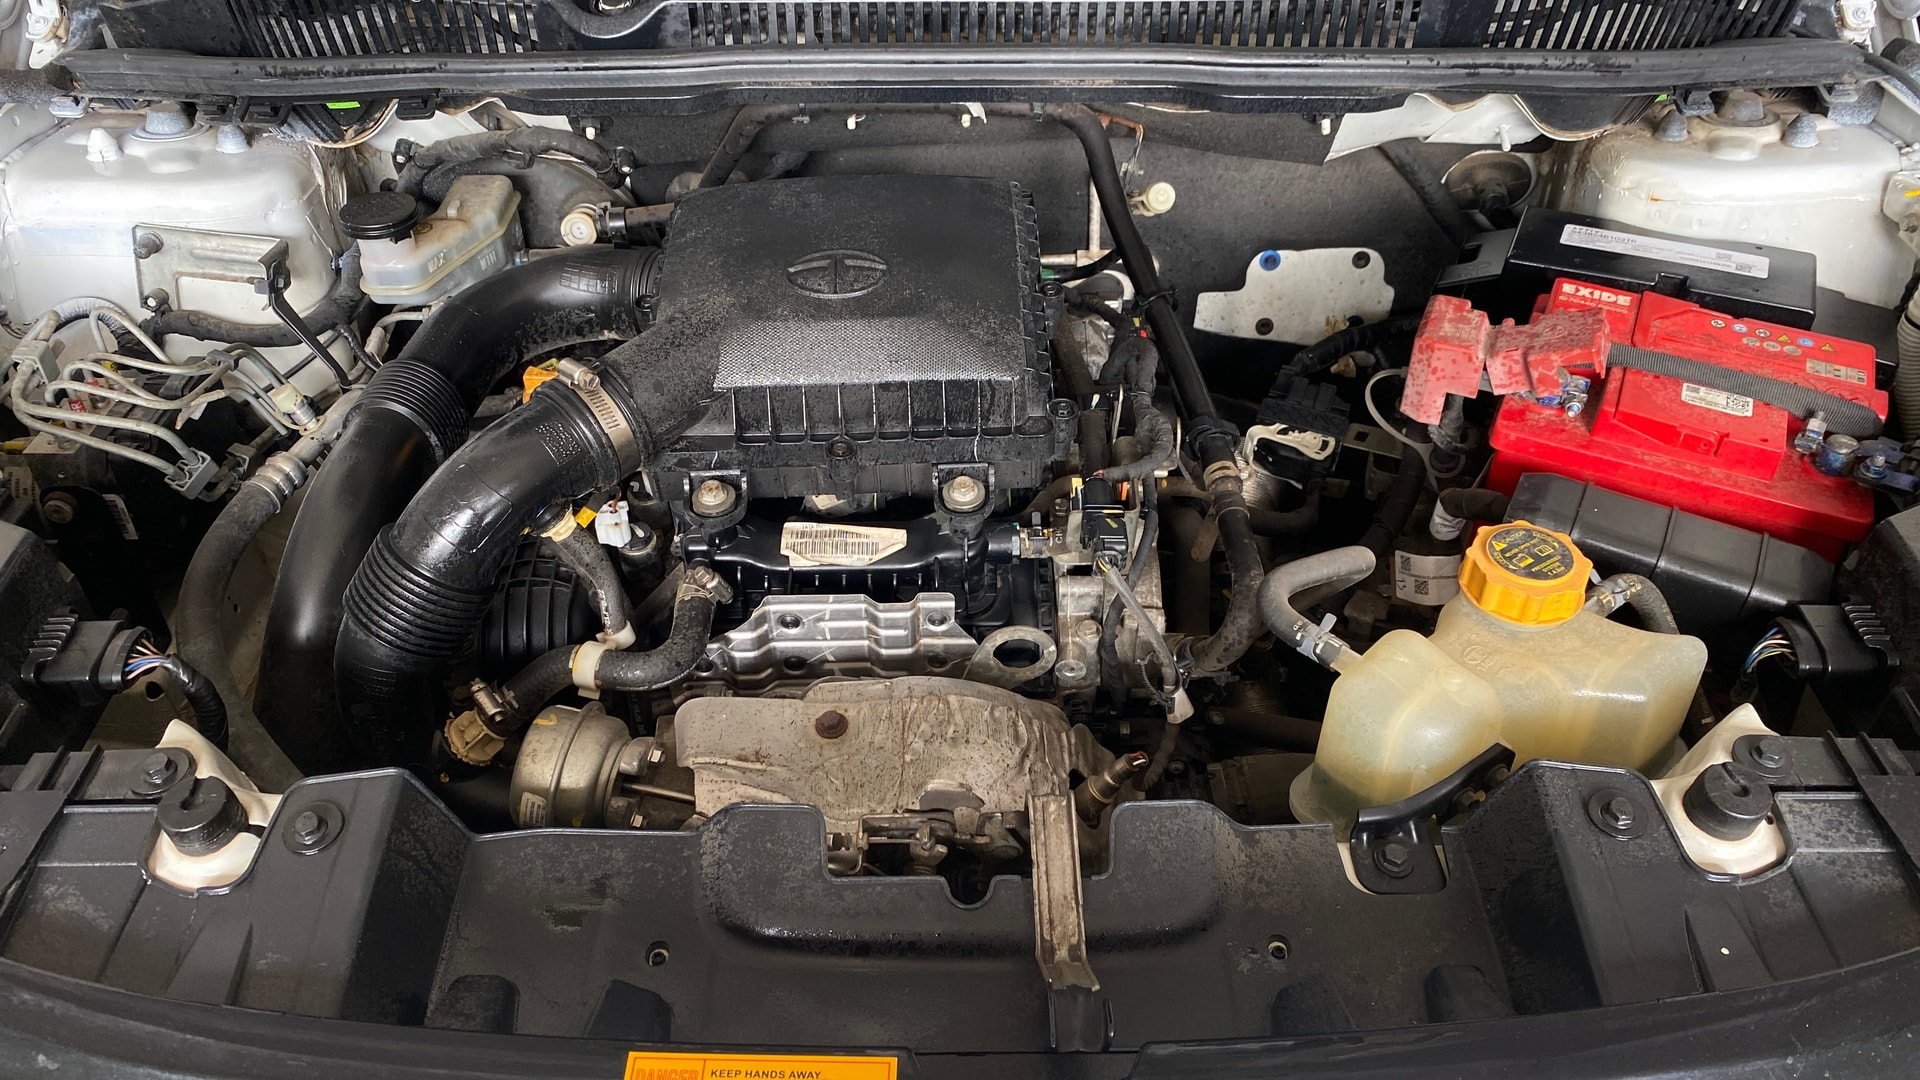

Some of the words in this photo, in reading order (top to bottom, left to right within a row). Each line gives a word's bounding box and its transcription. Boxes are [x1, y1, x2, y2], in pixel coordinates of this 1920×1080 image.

[427, 252, 446, 273] MAX
[480, 250, 497, 271] MIN
[1562, 283, 1632, 306] EXIDE
[1502, 530, 1526, 543] CAUTION
[635, 1068, 699, 1080] DANGER
[711, 1069, 741, 1078] KEEP
[745, 1070, 785, 1079] HANDS
[788, 1070, 821, 1079] AWAY
